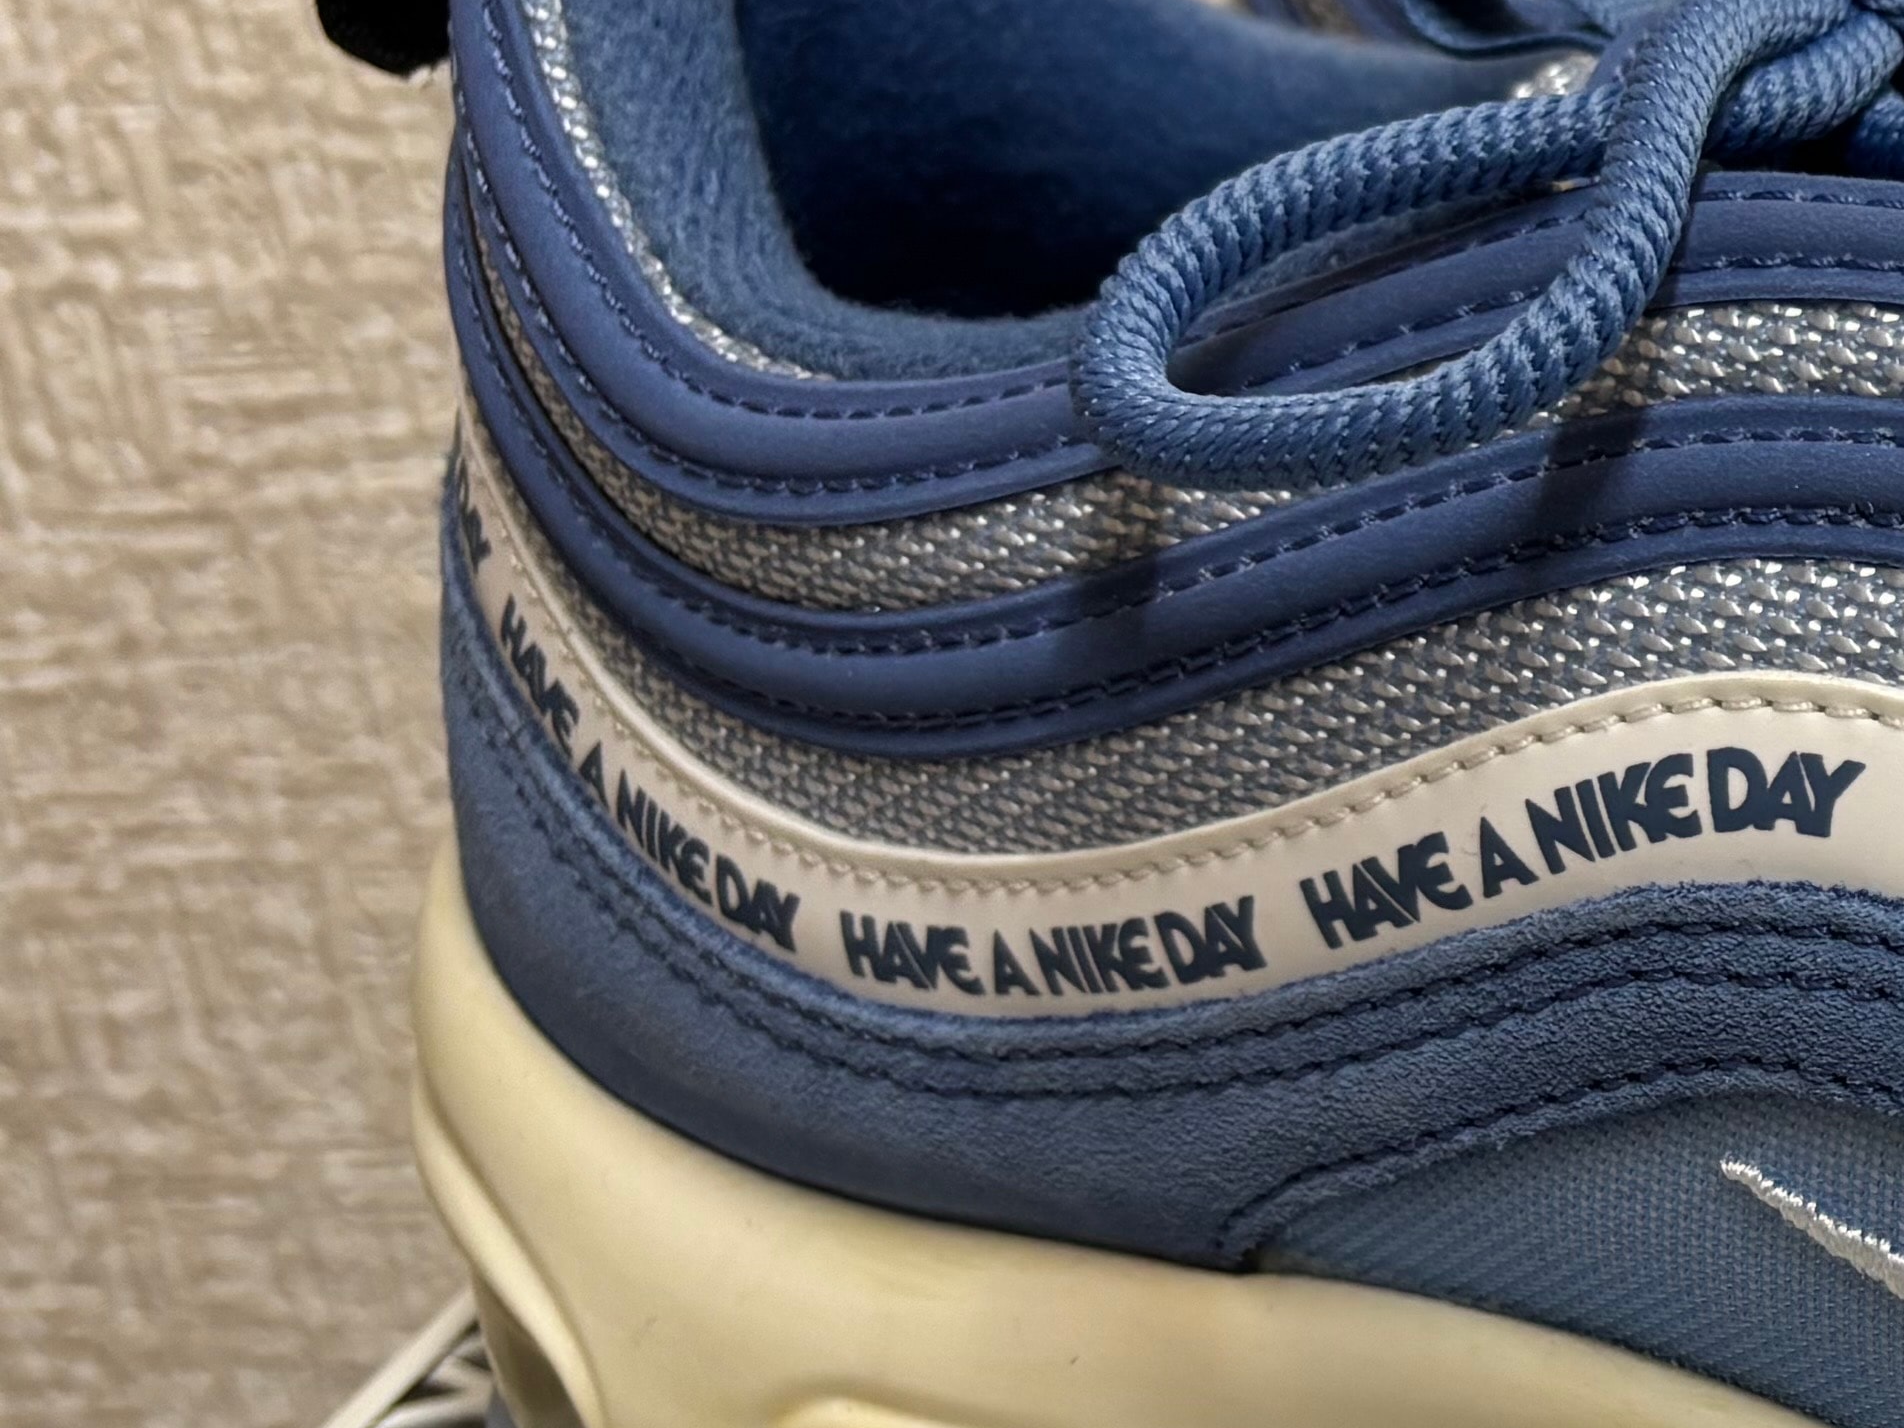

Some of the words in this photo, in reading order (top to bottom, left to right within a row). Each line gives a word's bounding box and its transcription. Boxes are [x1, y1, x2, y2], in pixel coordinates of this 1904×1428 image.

[500, 594, 579, 760] HAVE
[578, 740, 612, 812] A
[617, 769, 713, 907] NIKE
[716, 854, 801, 953] DAY
[1300, 828, 1473, 949] HAVE
[1479, 816, 1540, 897] A
[1523, 751, 1700, 874] NIKE
[1706, 747, 1867, 837] DAY
[839, 909, 988, 997] HAVE
[993, 928, 1034, 997] A
[1040, 917, 1166, 997] NIKE
[1161, 894, 1267, 982] DAY
